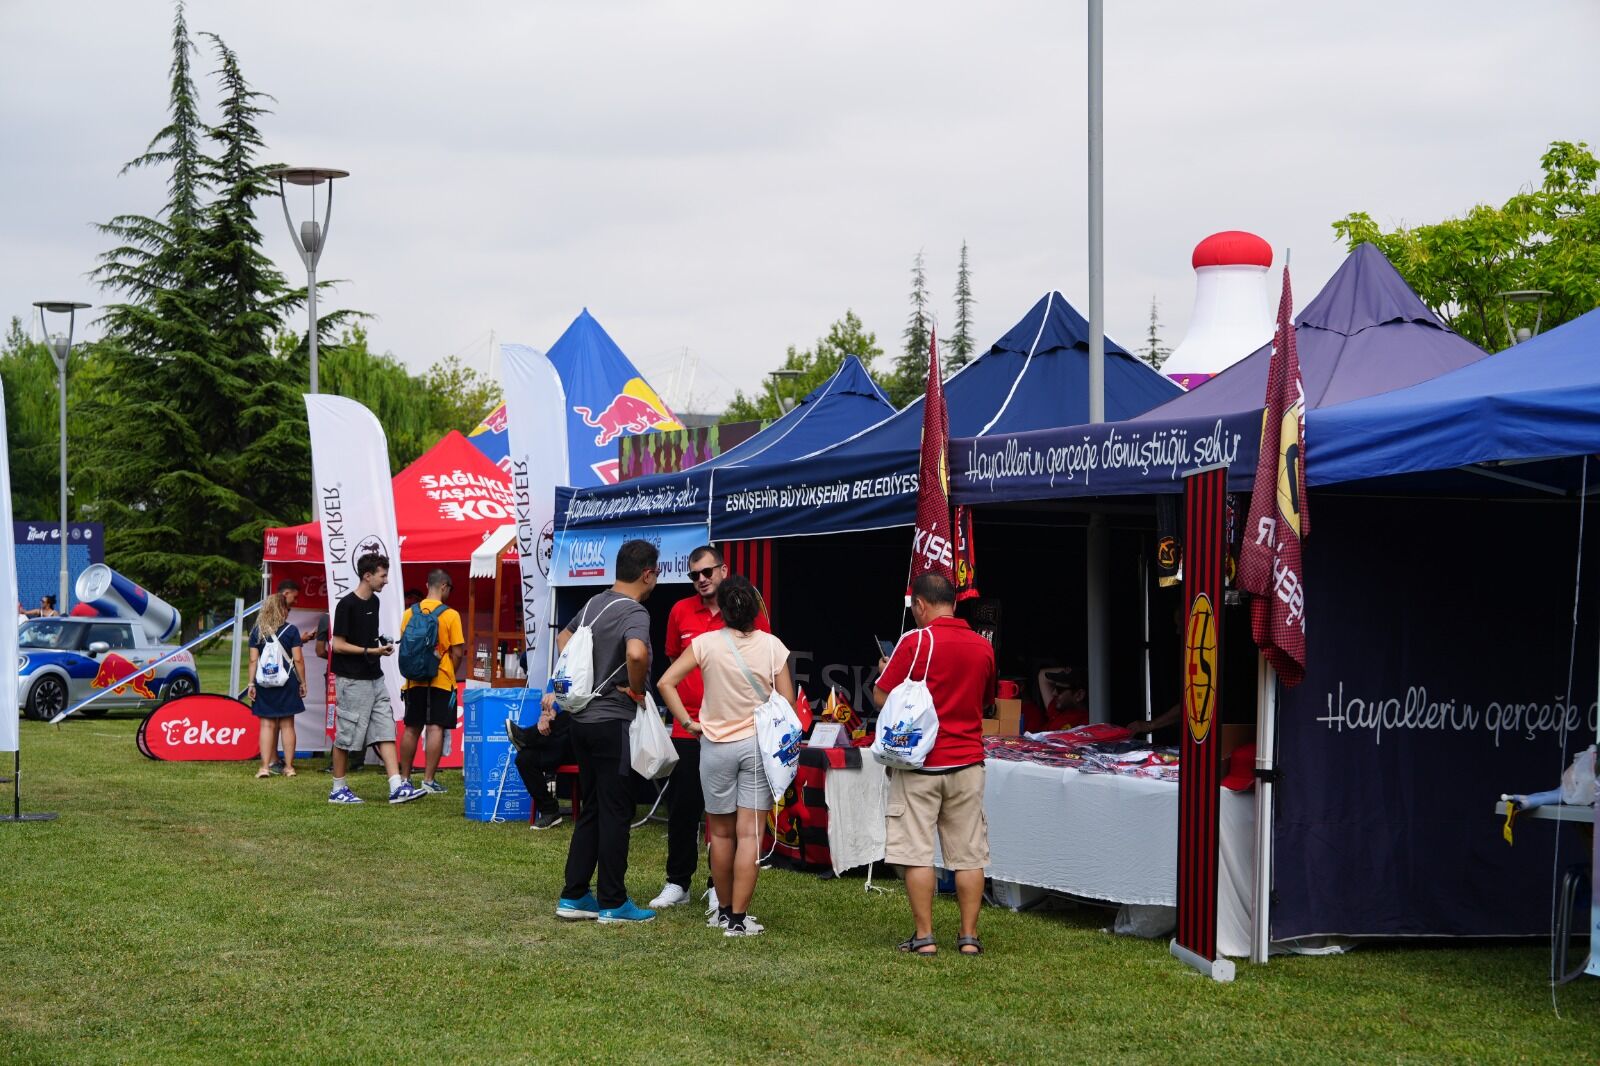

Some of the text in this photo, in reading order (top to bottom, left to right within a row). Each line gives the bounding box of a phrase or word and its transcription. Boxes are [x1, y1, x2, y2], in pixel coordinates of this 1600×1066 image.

[965, 418, 1241, 492] Hayallerin gerçeğe dönüştüğü şehir
[427, 487, 490, 501] YAŞAM
[725, 472, 919, 513] ESKİŞEHİR BÜYÜKŞEHİR BELEDİYES
[658, 551, 690, 578] uyu İçili
[915, 522, 953, 570] KİŞE
[1316, 681, 1480, 745] Hayallerin
[1485, 695, 1581, 749] gerçeğe
